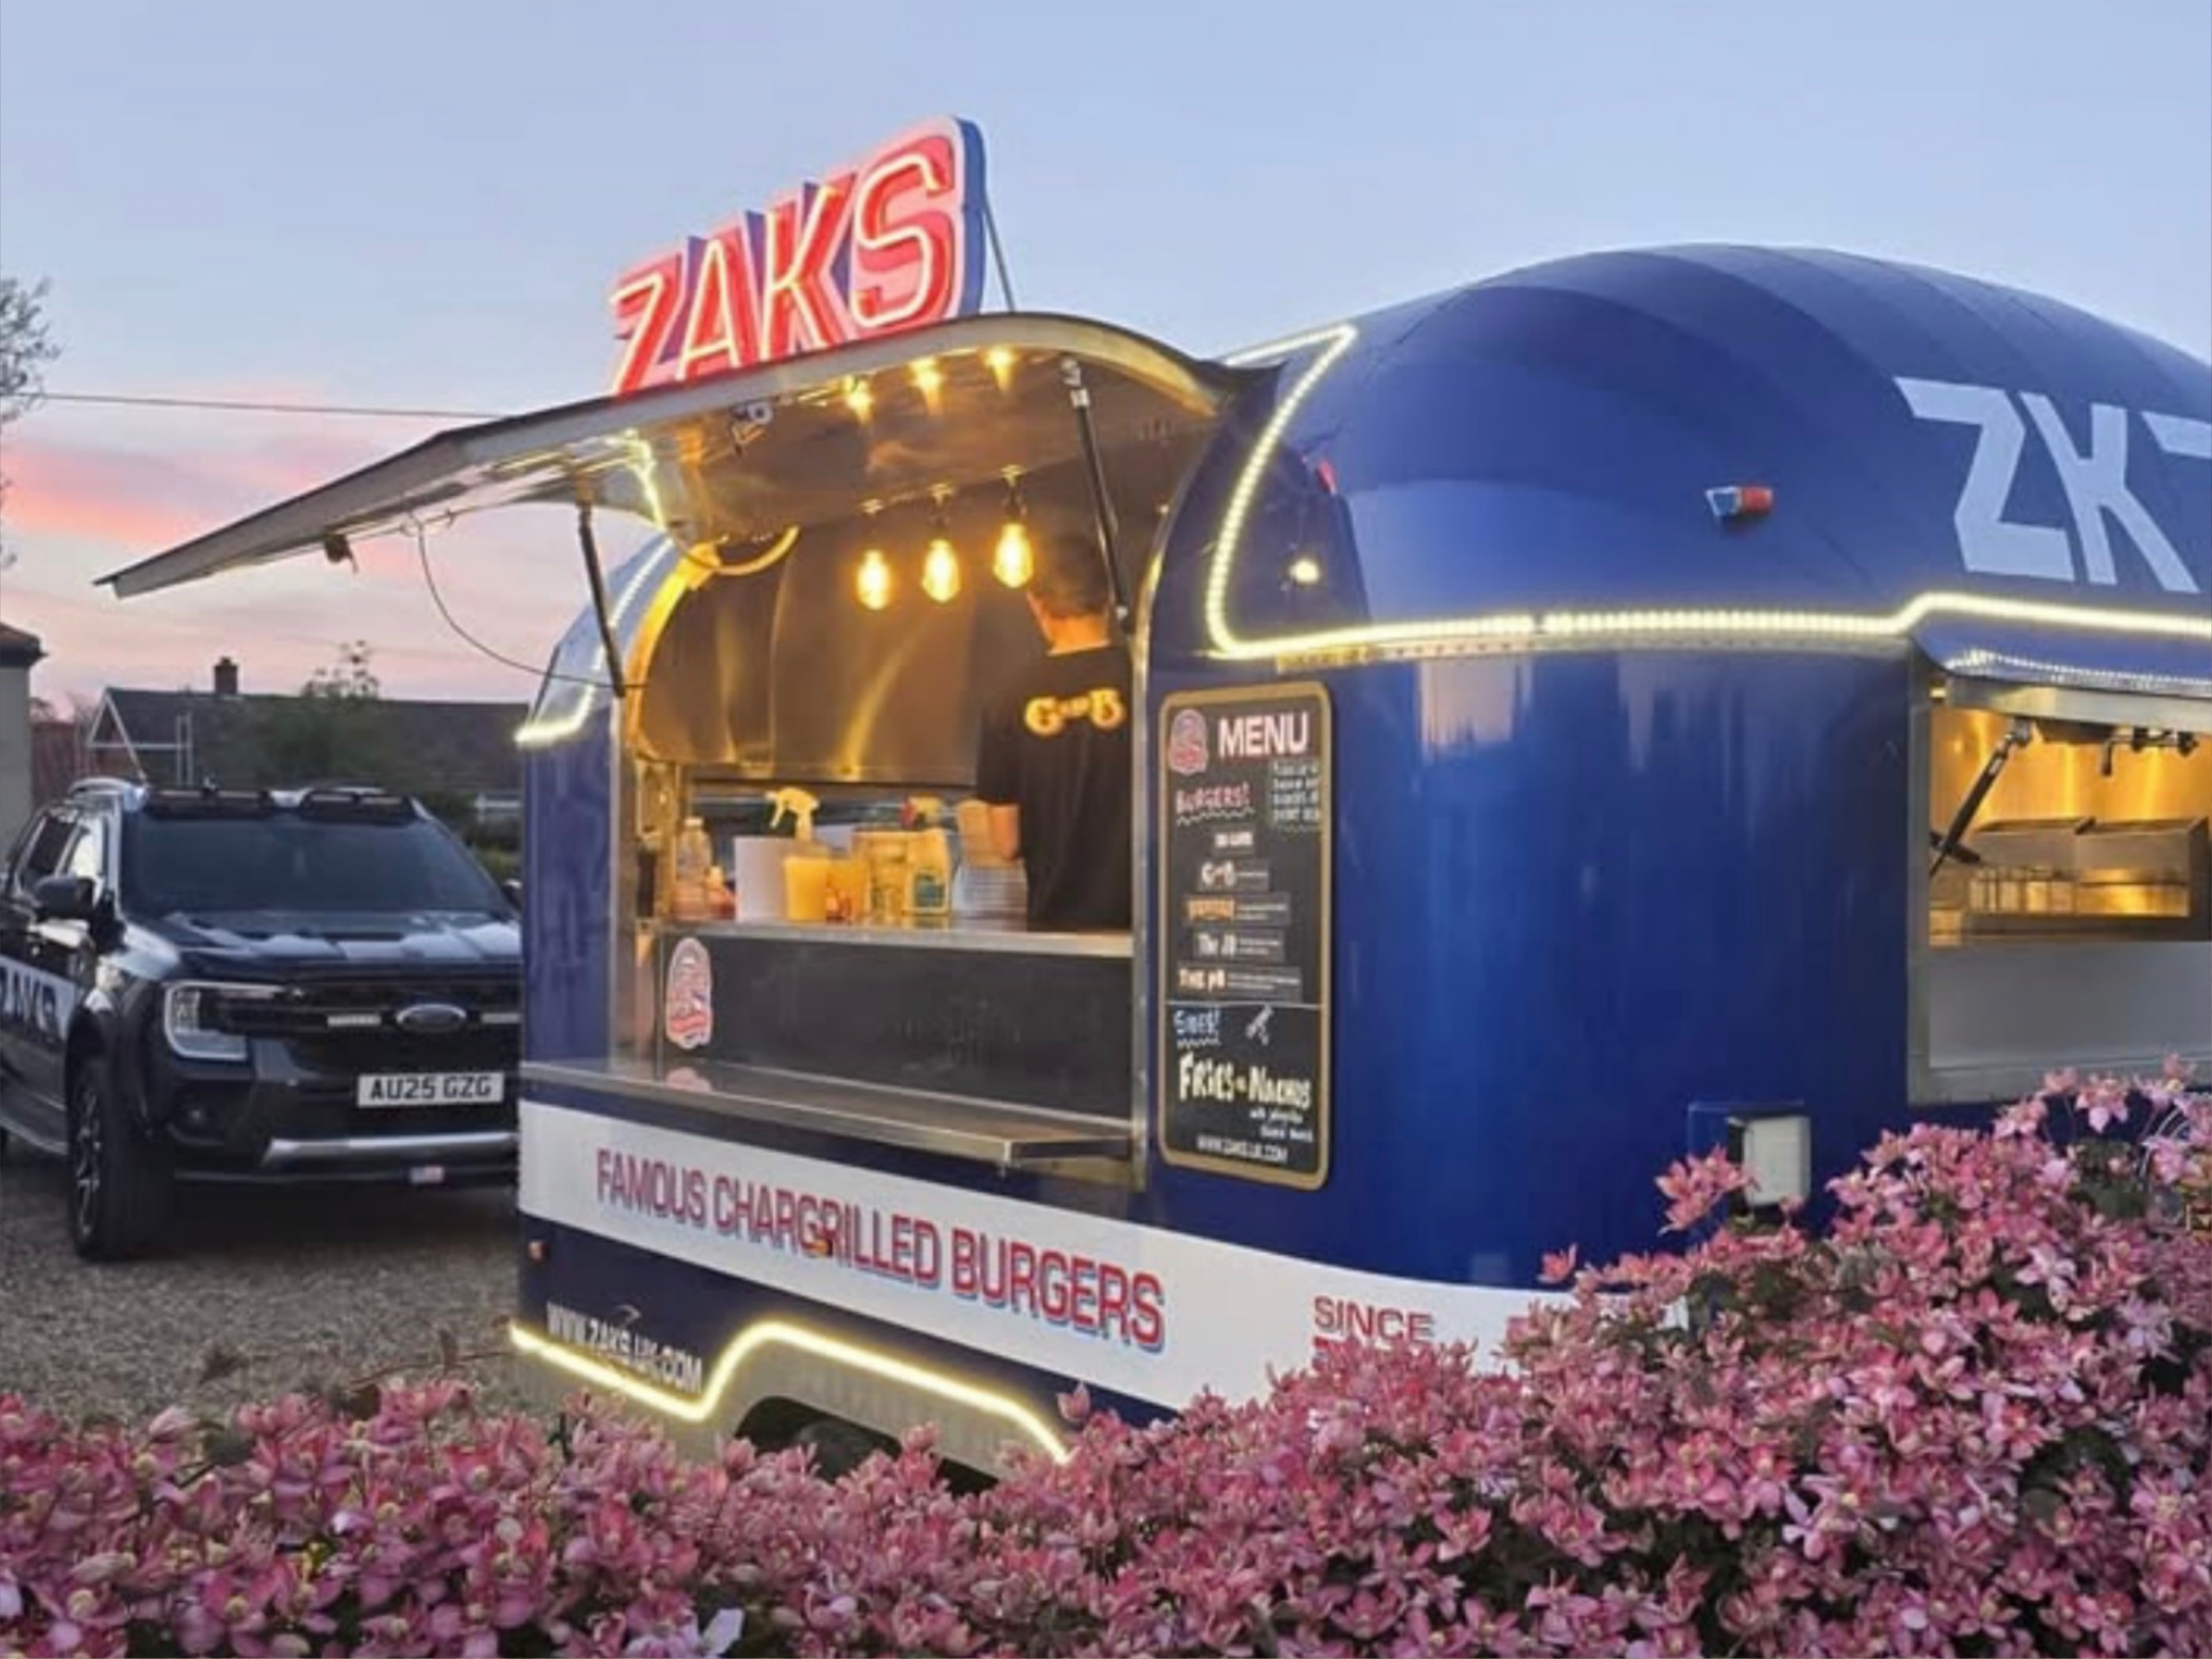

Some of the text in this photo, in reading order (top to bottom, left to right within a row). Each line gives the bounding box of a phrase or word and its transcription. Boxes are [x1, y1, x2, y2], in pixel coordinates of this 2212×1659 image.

[609, 121, 963, 394] ZAKS
[1218, 713, 1309, 758] MENU
[370, 1077, 435, 1100] AU25
[595, 1147, 1165, 1354] FAMOUS CHARGRILLED BURGERS
[1313, 1296, 1435, 1340] SINCE
